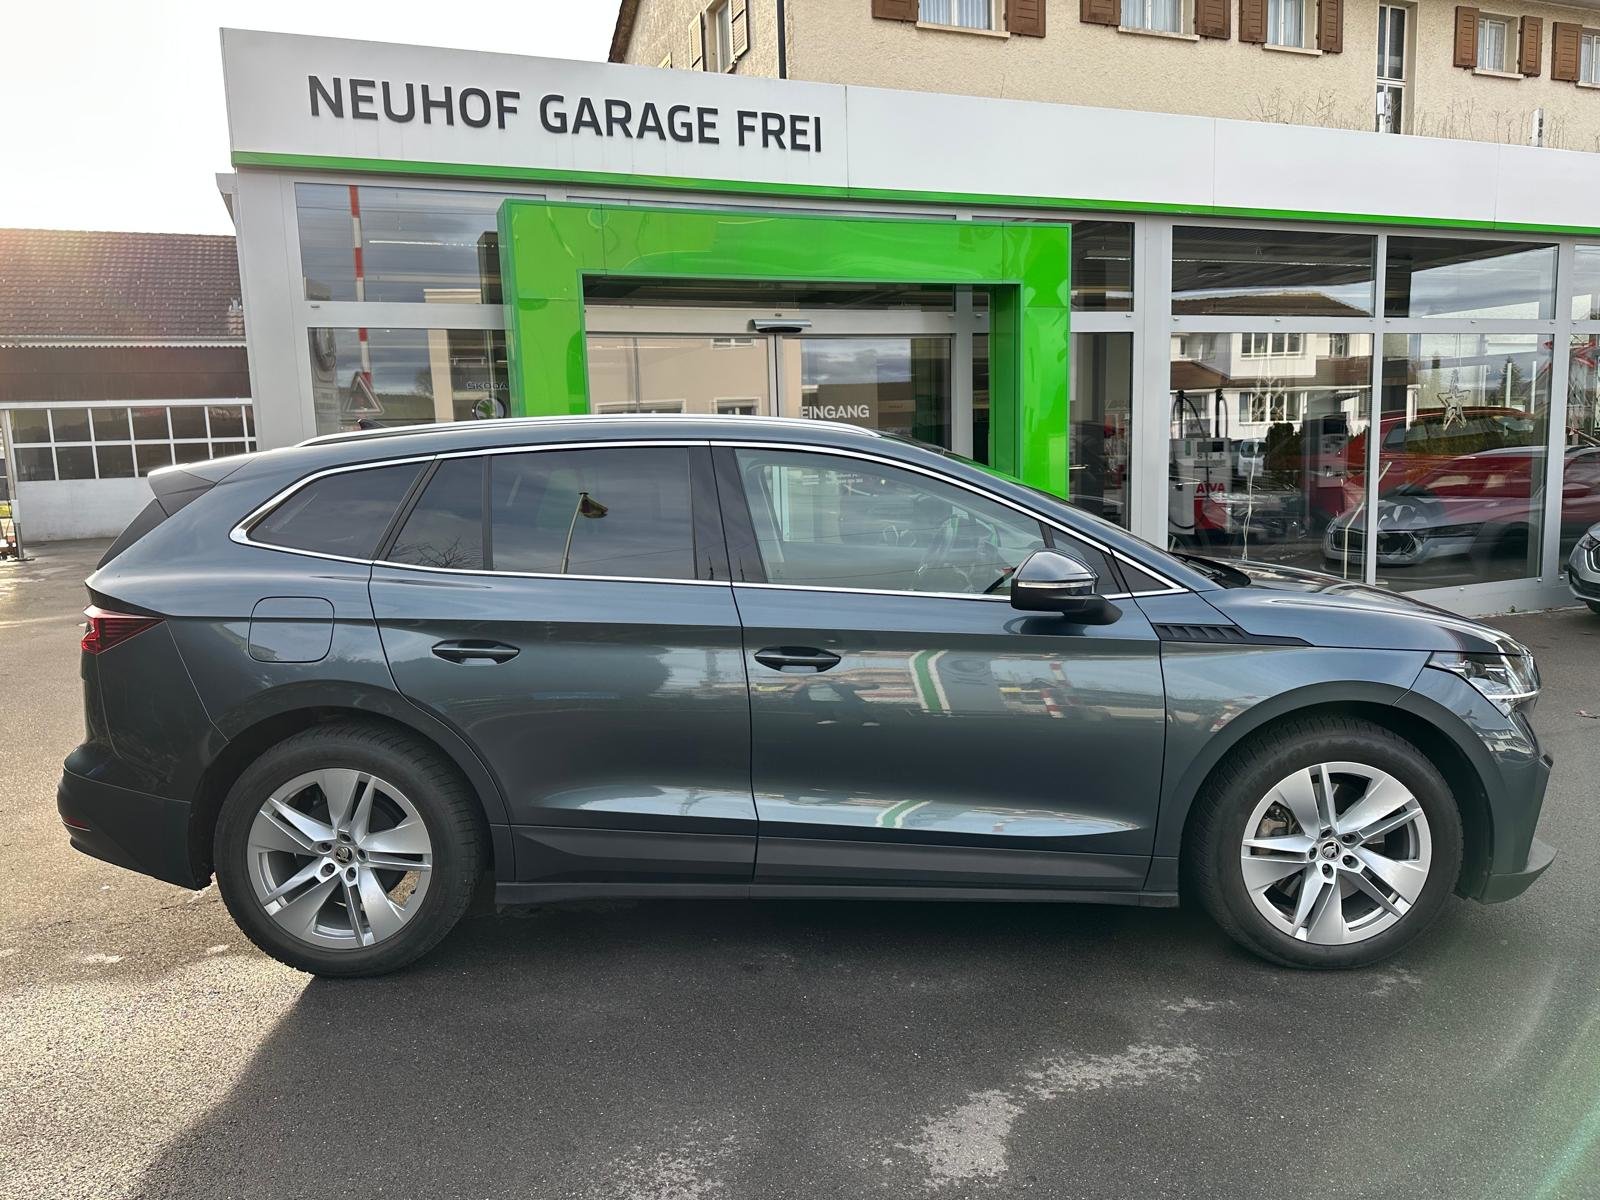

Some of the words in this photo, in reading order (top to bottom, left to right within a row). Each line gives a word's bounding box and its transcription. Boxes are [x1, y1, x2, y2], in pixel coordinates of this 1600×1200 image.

[308, 75, 521, 130] NEUHOF
[539, 94, 720, 145] GARAGE
[737, 110, 822, 153] FREI
[801, 404, 870, 419] EINGANG
